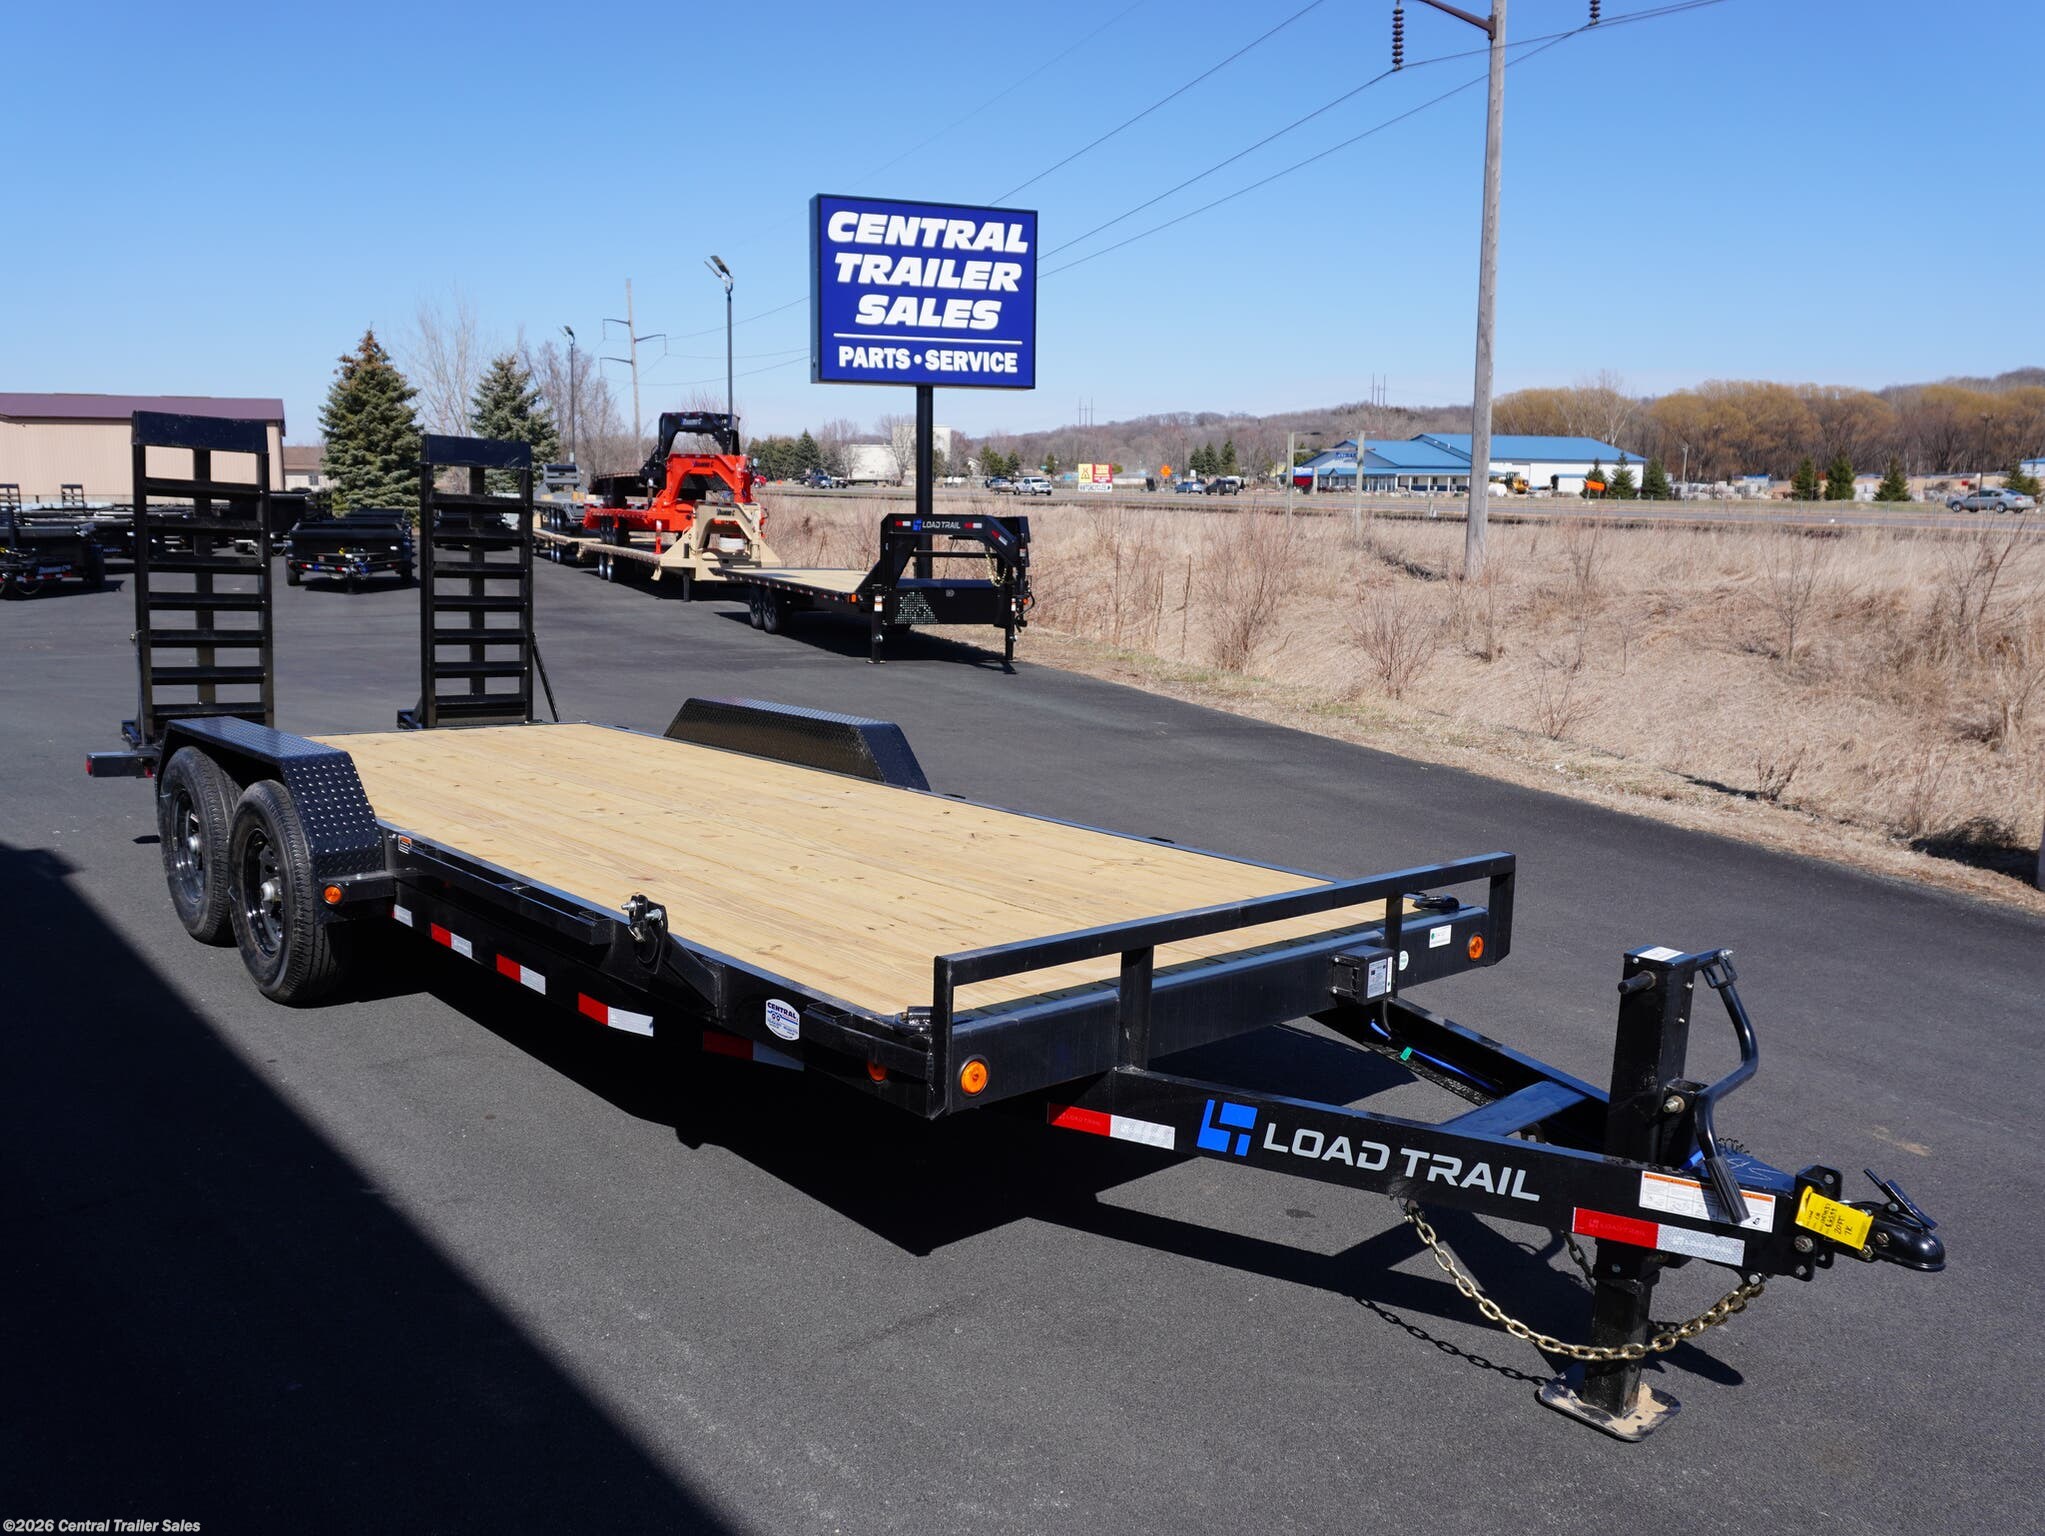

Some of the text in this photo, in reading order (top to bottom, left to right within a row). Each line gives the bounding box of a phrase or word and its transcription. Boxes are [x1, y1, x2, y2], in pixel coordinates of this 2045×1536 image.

[827, 211, 1029, 254] CENTRAL
[834, 252, 1023, 292] TRAILER
[855, 294, 1002, 331] SALES
[838, 346, 1019, 374] PARTS SERVICE
[922, 521, 961, 530] LOAD TRAIL
[767, 1002, 797, 1019] CENTRAL
[1263, 1122, 1540, 1202] LOAD TRAIL
